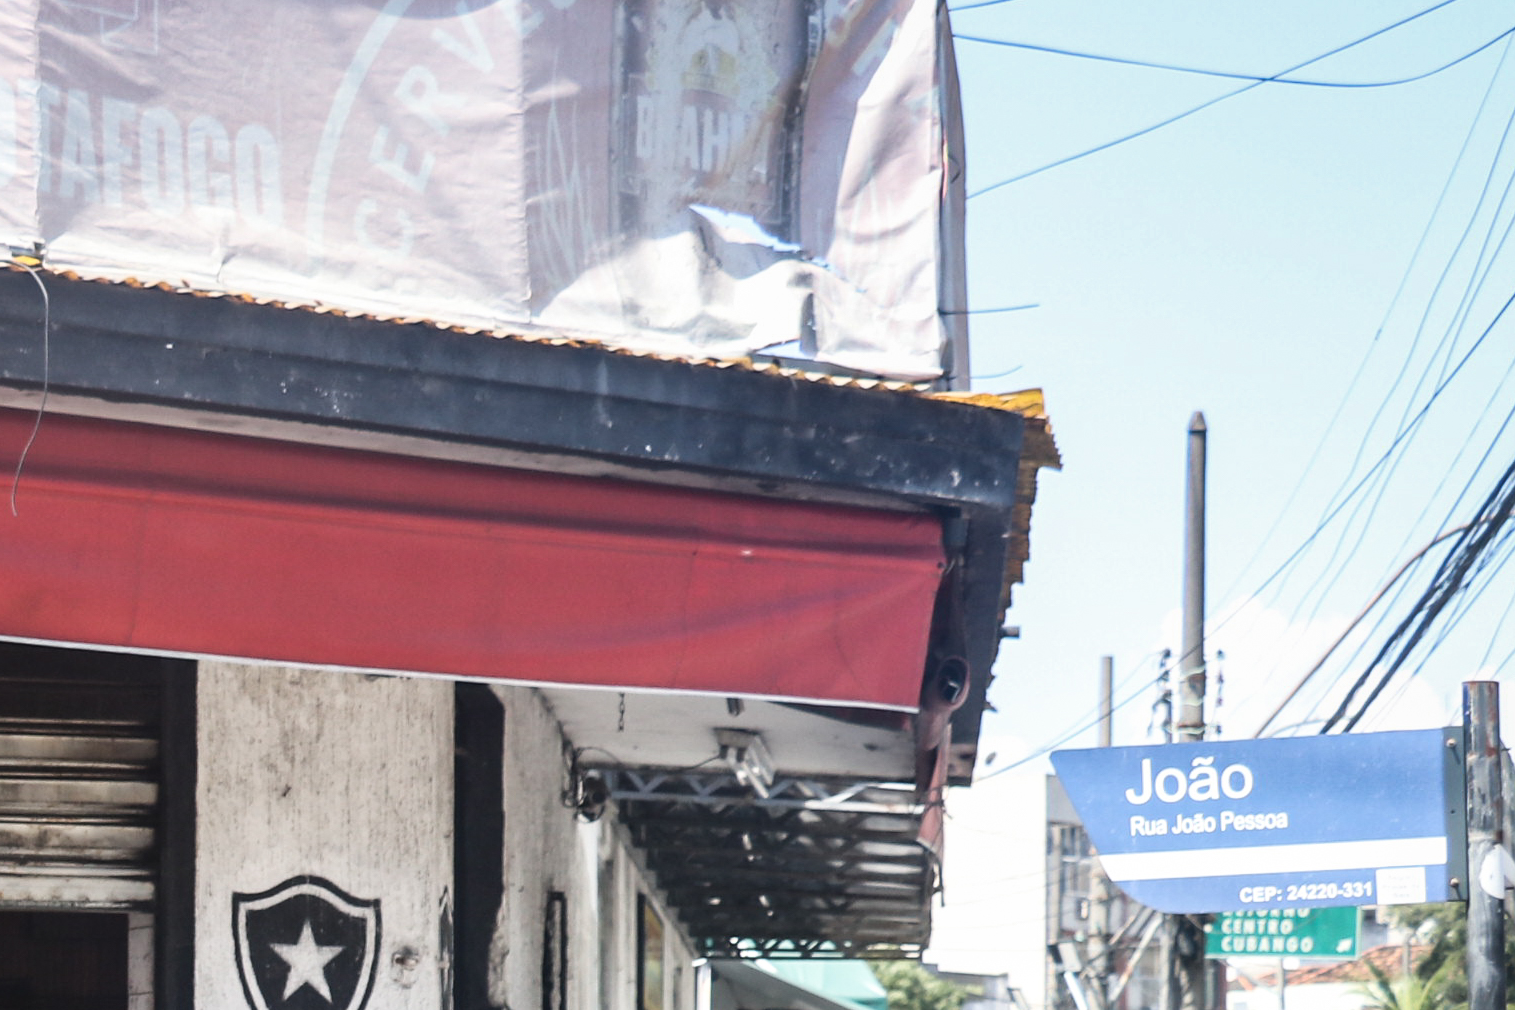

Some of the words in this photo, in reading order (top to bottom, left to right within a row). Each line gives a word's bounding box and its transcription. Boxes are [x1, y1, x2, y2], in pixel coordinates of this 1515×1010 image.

[1125, 755, 1253, 805] João
[1130, 815, 1167, 837] Rua
[1171, 811, 1216, 835] João
[1220, 809, 1288, 832] Pessoa
[1239, 884, 1282, 903] CEP:
[1286, 880, 1373, 901] 24220-331
[1221, 918, 1294, 934] CENTRO
[1221, 935, 1314, 953] CUBANGO
